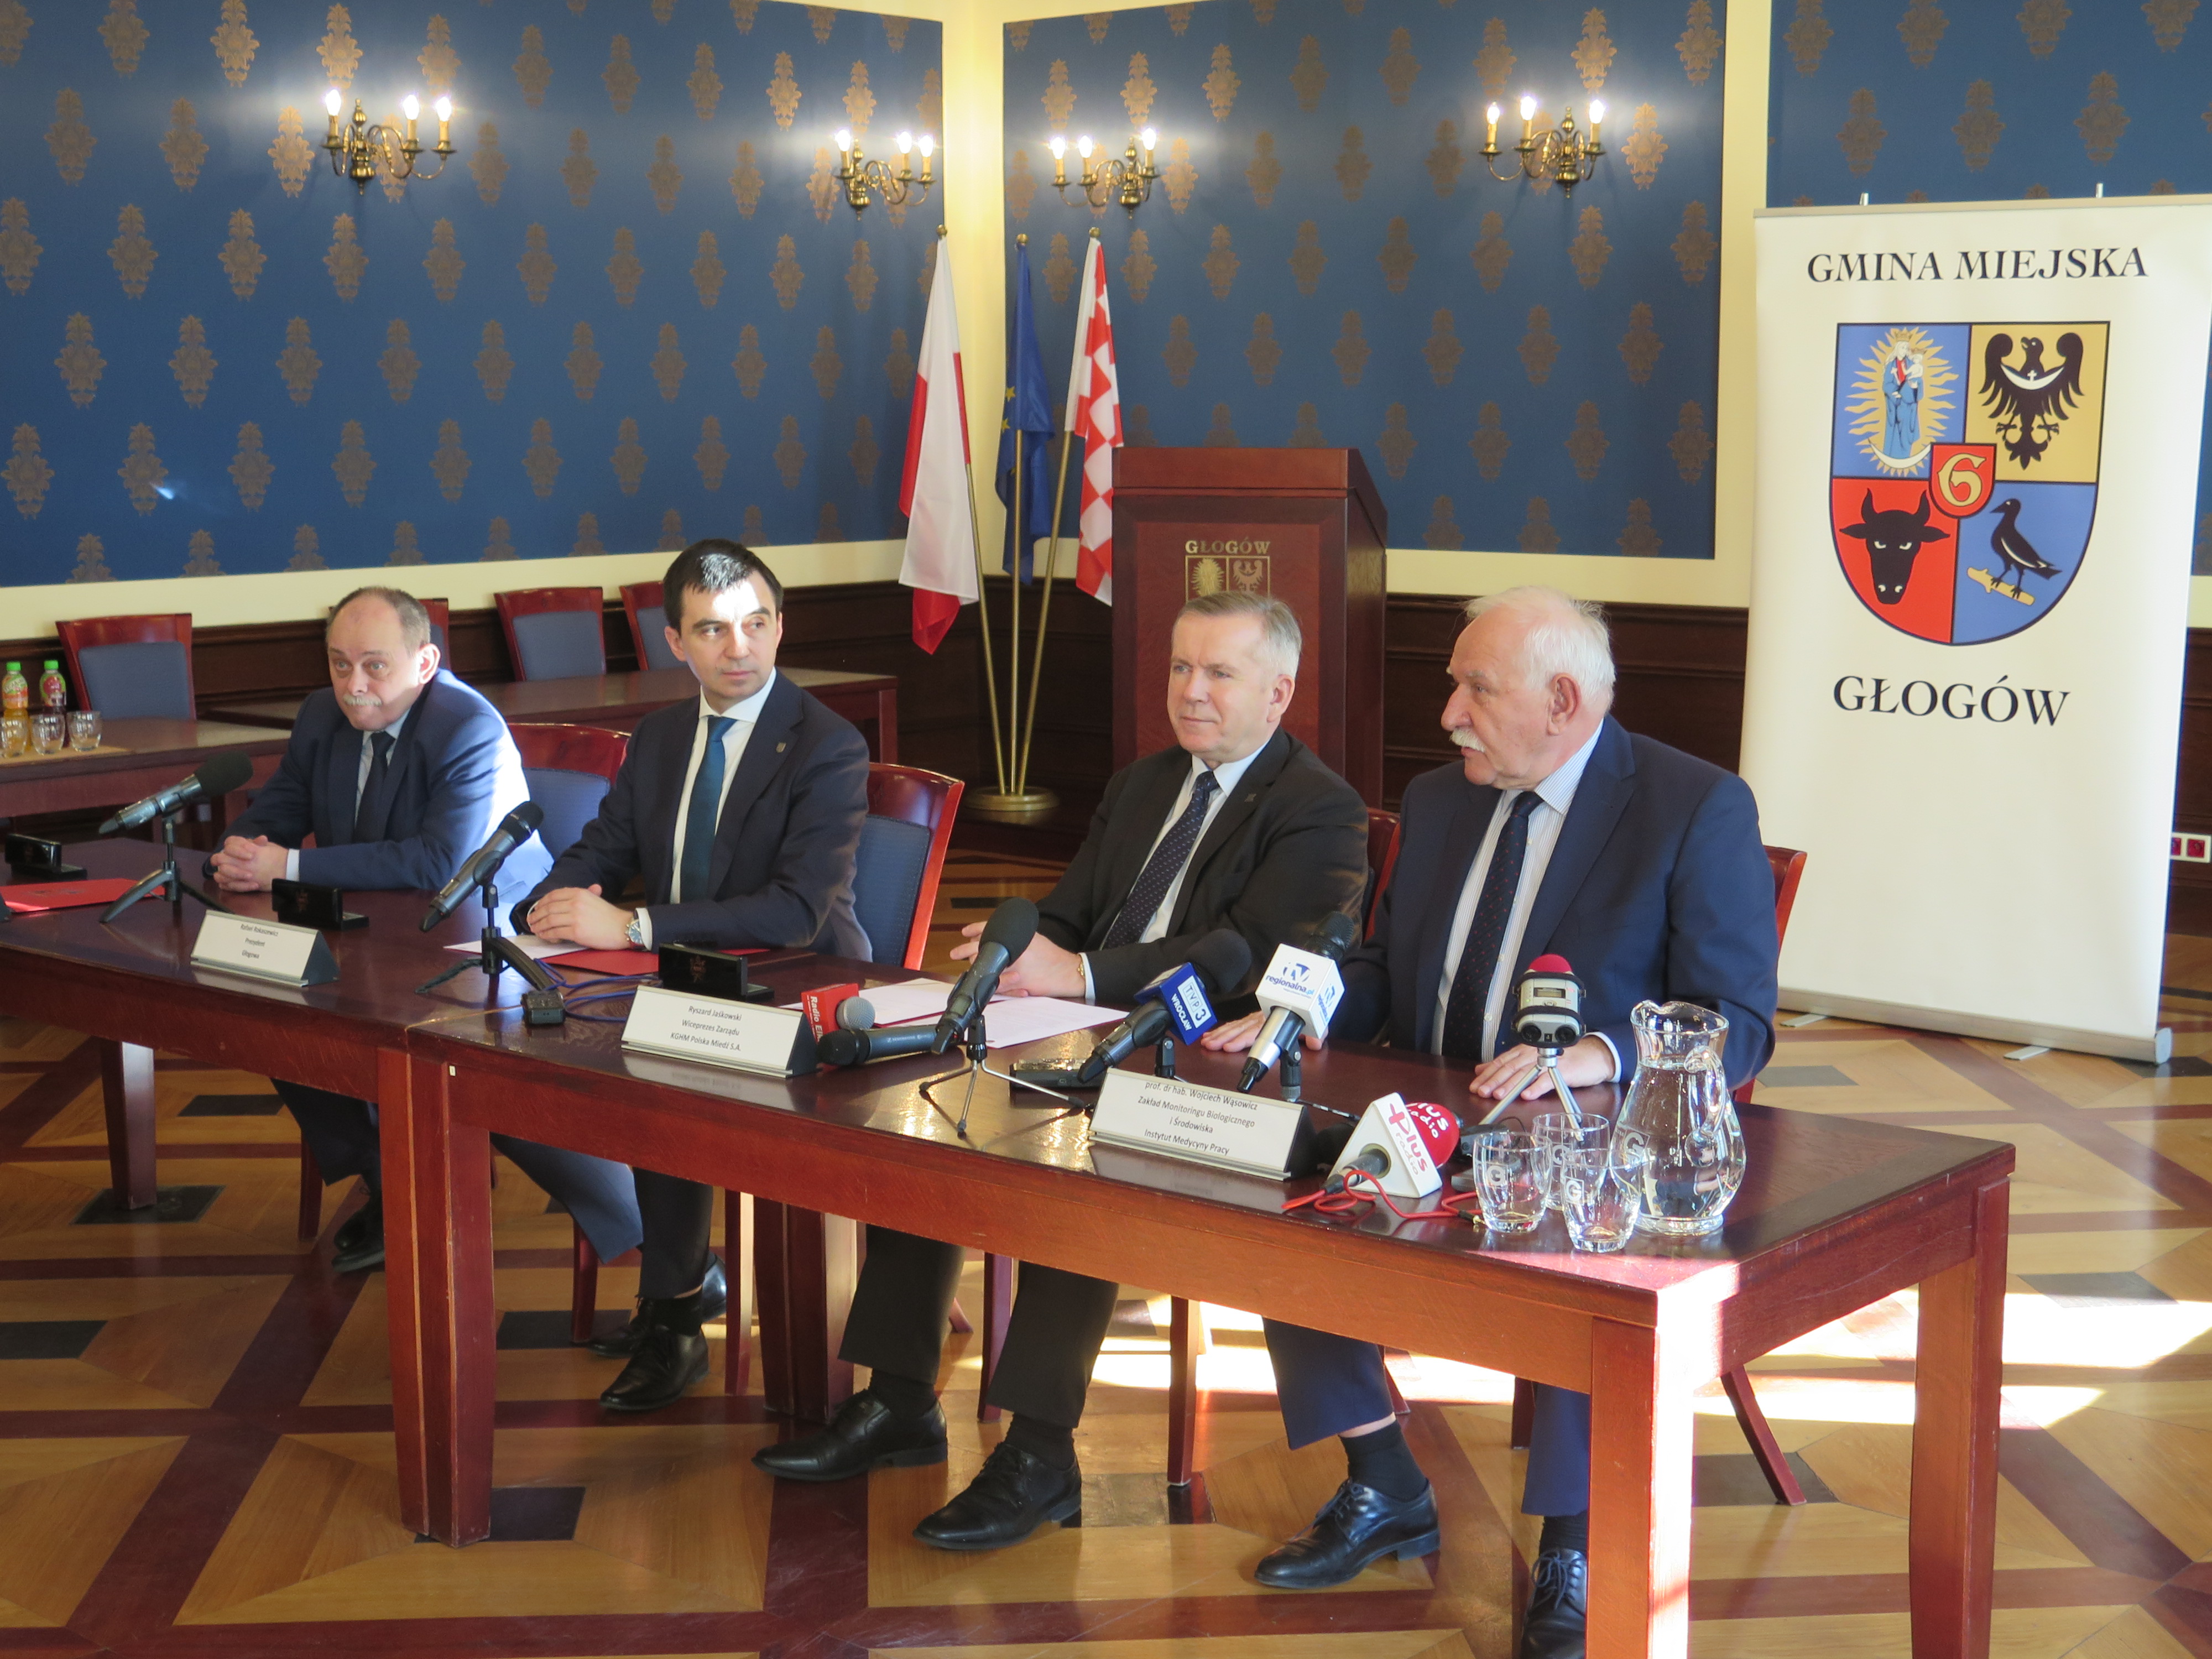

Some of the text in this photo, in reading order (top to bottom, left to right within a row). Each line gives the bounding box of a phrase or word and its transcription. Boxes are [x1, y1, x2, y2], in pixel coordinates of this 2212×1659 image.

[1808, 247, 2149, 283] GMINA MIEJSKA
[1185, 537, 1271, 554] GŁOGÓW
[1834, 675, 2070, 726] GŁOGÓW
[688, 1005, 712, 1016] Ryszard
[810, 996, 820, 1022] Radio
[1171, 993, 1192, 1031] WROCŁAW
[670, 1032, 690, 1041] KGHM
[690, 1036, 709, 1046] Polska
[682, 1019, 740, 1036] Wiceprezes Zarządu
[1145, 1082, 1161, 1091] prof.
[1172, 1086, 1187, 1095] hab.
[1190, 1089, 1221, 1103] Wojciech
[1223, 1096, 1258, 1110] Wąsowicz
[1138, 1095, 1255, 1129] Zakład Monitoringu Biologicznego
[1173, 1116, 1213, 1134] Środowiska
[1144, 1129, 1230, 1156] Instytut Medycyny Pracy
[1488, 1165, 1506, 1186] G
[1566, 1180, 1583, 1202] G
